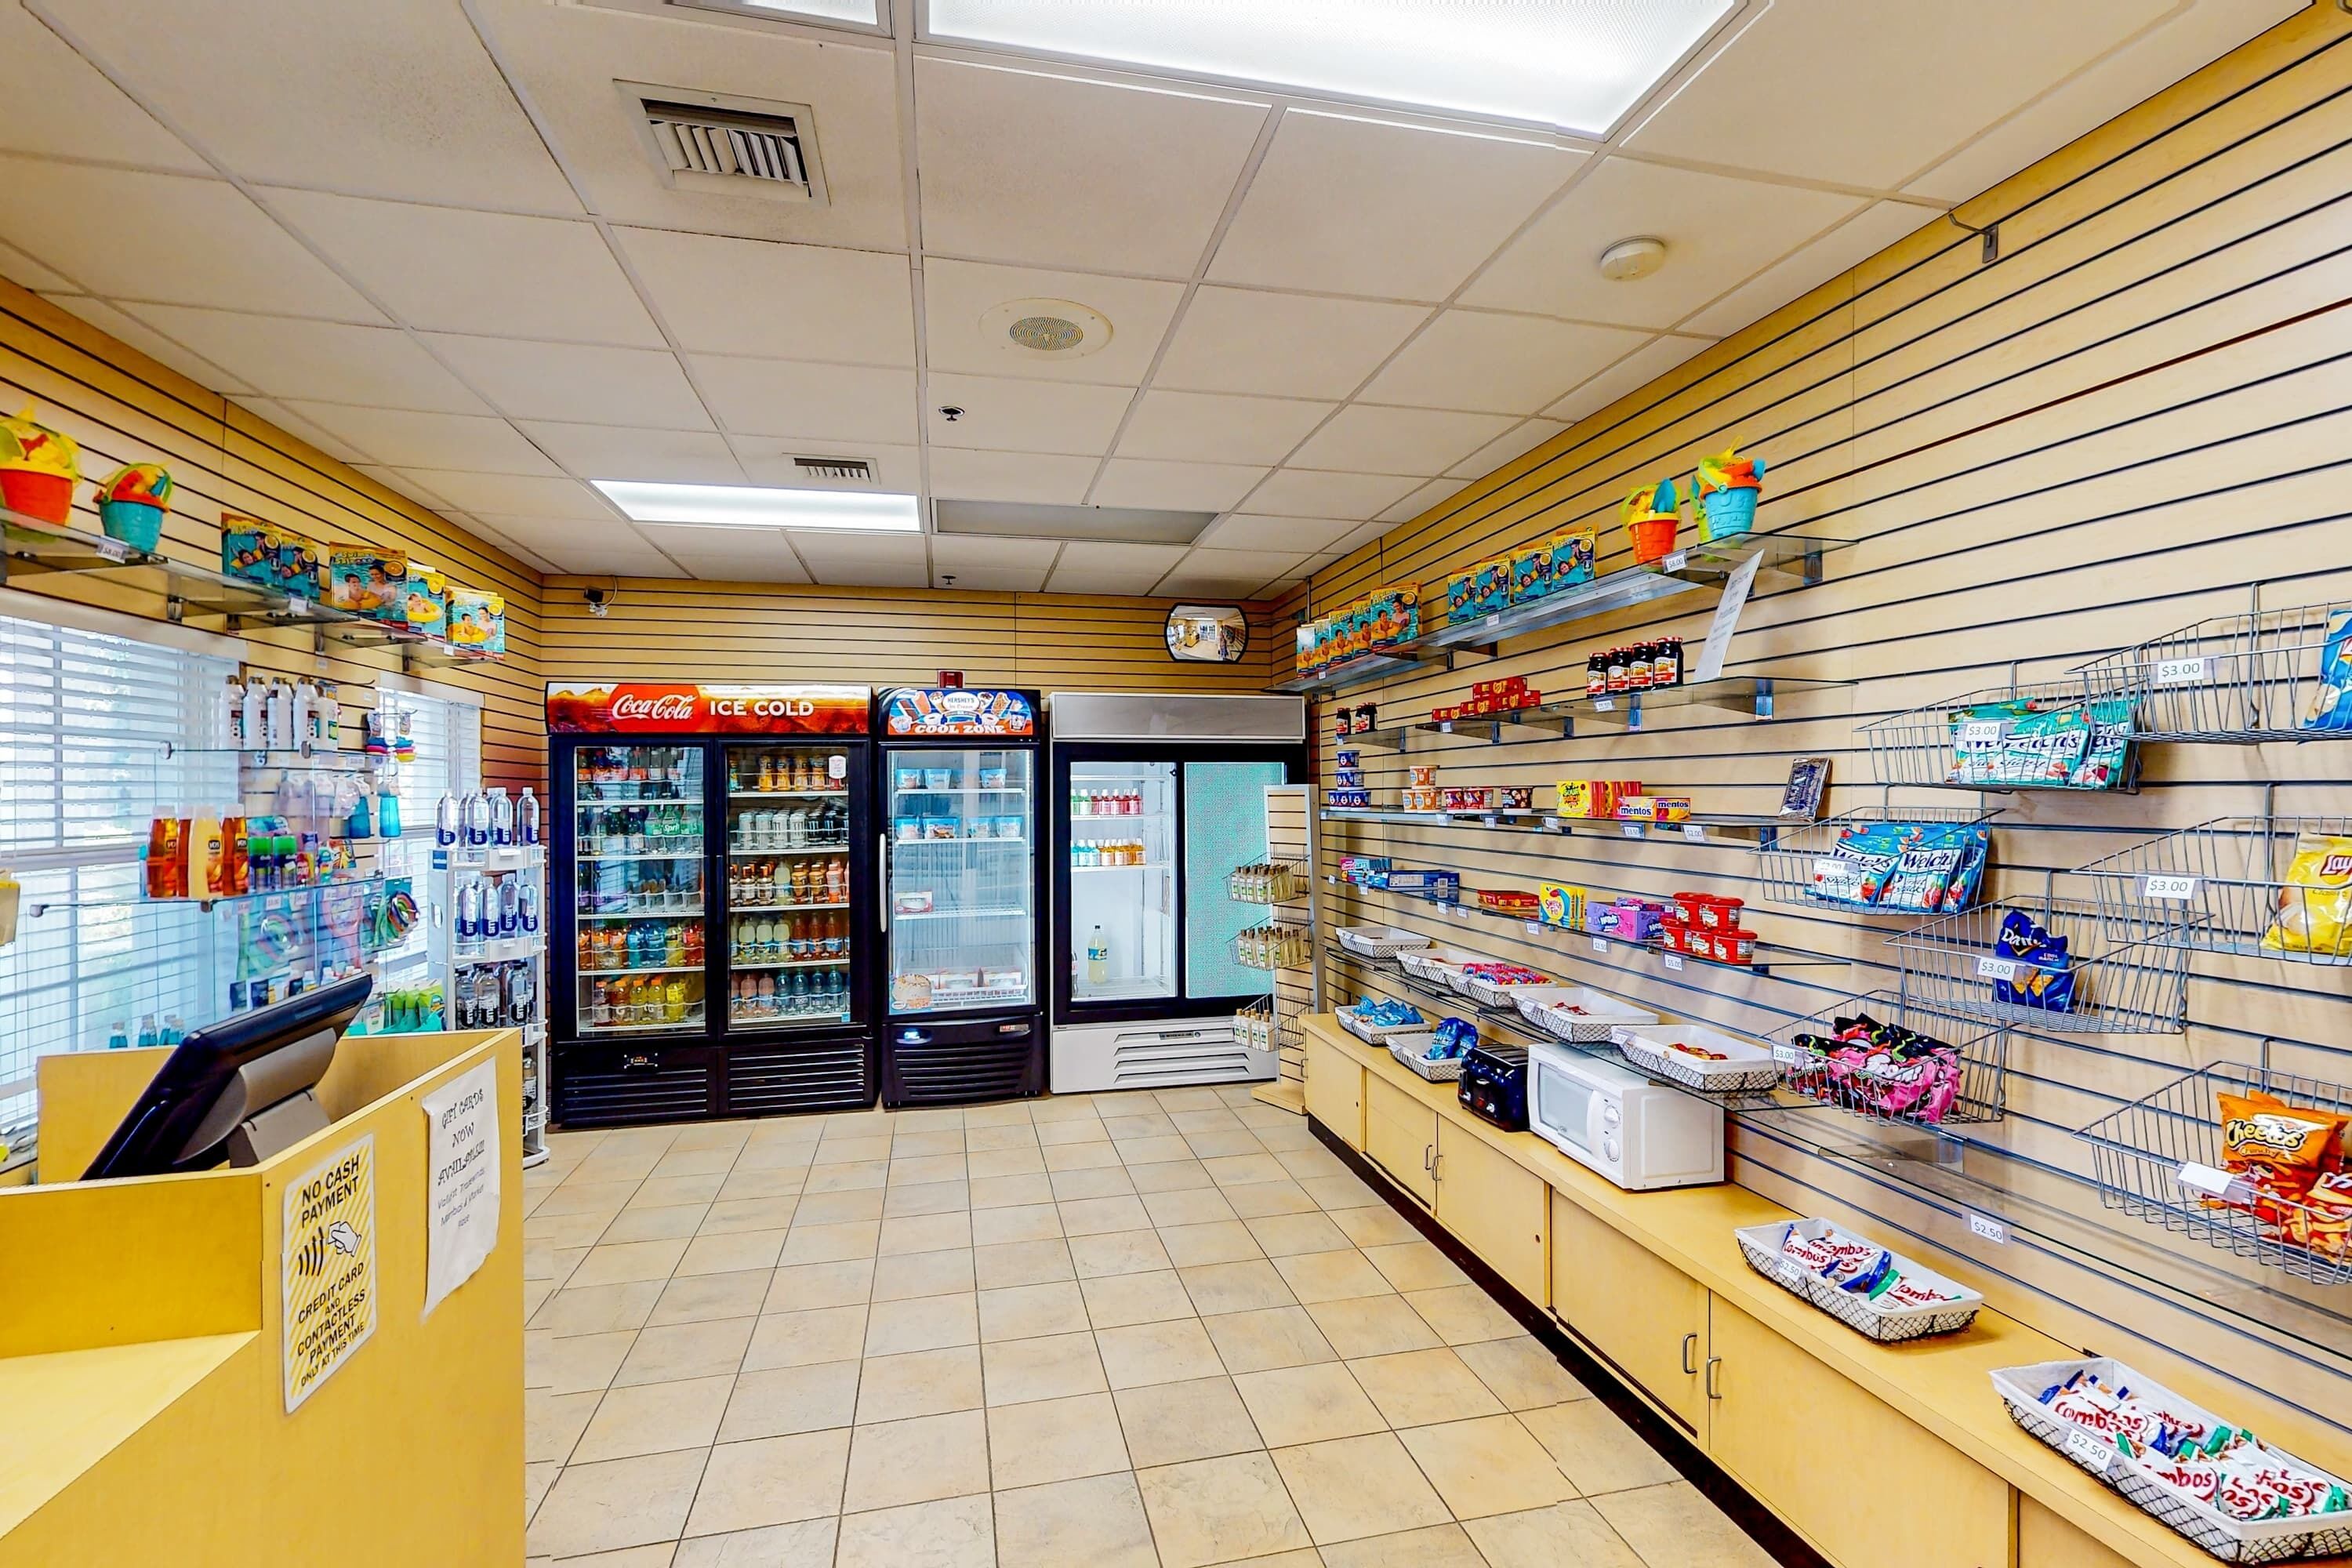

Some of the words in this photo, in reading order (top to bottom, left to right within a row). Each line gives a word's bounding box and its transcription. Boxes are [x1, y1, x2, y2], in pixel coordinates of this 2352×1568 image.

[1669, 557, 1683, 568] $8.00
[2161, 662, 2201, 677] $3.00
[611, 694, 695, 720] Coca-Cola
[710, 700, 747, 717] ICE
[753, 700, 815, 717] COLD
[914, 725, 960, 734] COOL
[963, 725, 1007, 734] ZONE
[1969, 726, 1997, 735] $3.00
[1621, 807, 1652, 815] mentos
[2149, 879, 2188, 892] $3.00
[1981, 961, 2011, 975] $3.00
[1775, 1050, 1795, 1059] $3.00
[441, 1102, 458, 1130] GIFT
[459, 1087, 484, 1115] CARDS
[452, 1122, 474, 1149] NOW
[2226, 1120, 2305, 1149] Cheetos
[302, 1180, 321, 1207] NO
[325, 1154, 359, 1190] CASH
[302, 1176, 358, 1229] PAYMENT
[1974, 1221, 2002, 1240] $2.50
[1784, 1241, 1827, 1264] Combos
[1780, 1261, 1800, 1276] $2.50
[298, 1283, 336, 1324] CREDIT
[338, 1262, 364, 1291] CARD
[325, 1298, 340, 1316] AND
[297, 1288, 365, 1356] CONTACTLESS
[310, 1313, 355, 1364] PAYMENT
[301, 1363, 320, 1387] ONLY
[321, 1354, 330, 1370] AT
[332, 1341, 347, 1358] THIS
[348, 1321, 365, 1341] TIME
[2072, 1433, 2107, 1461] $2.50
